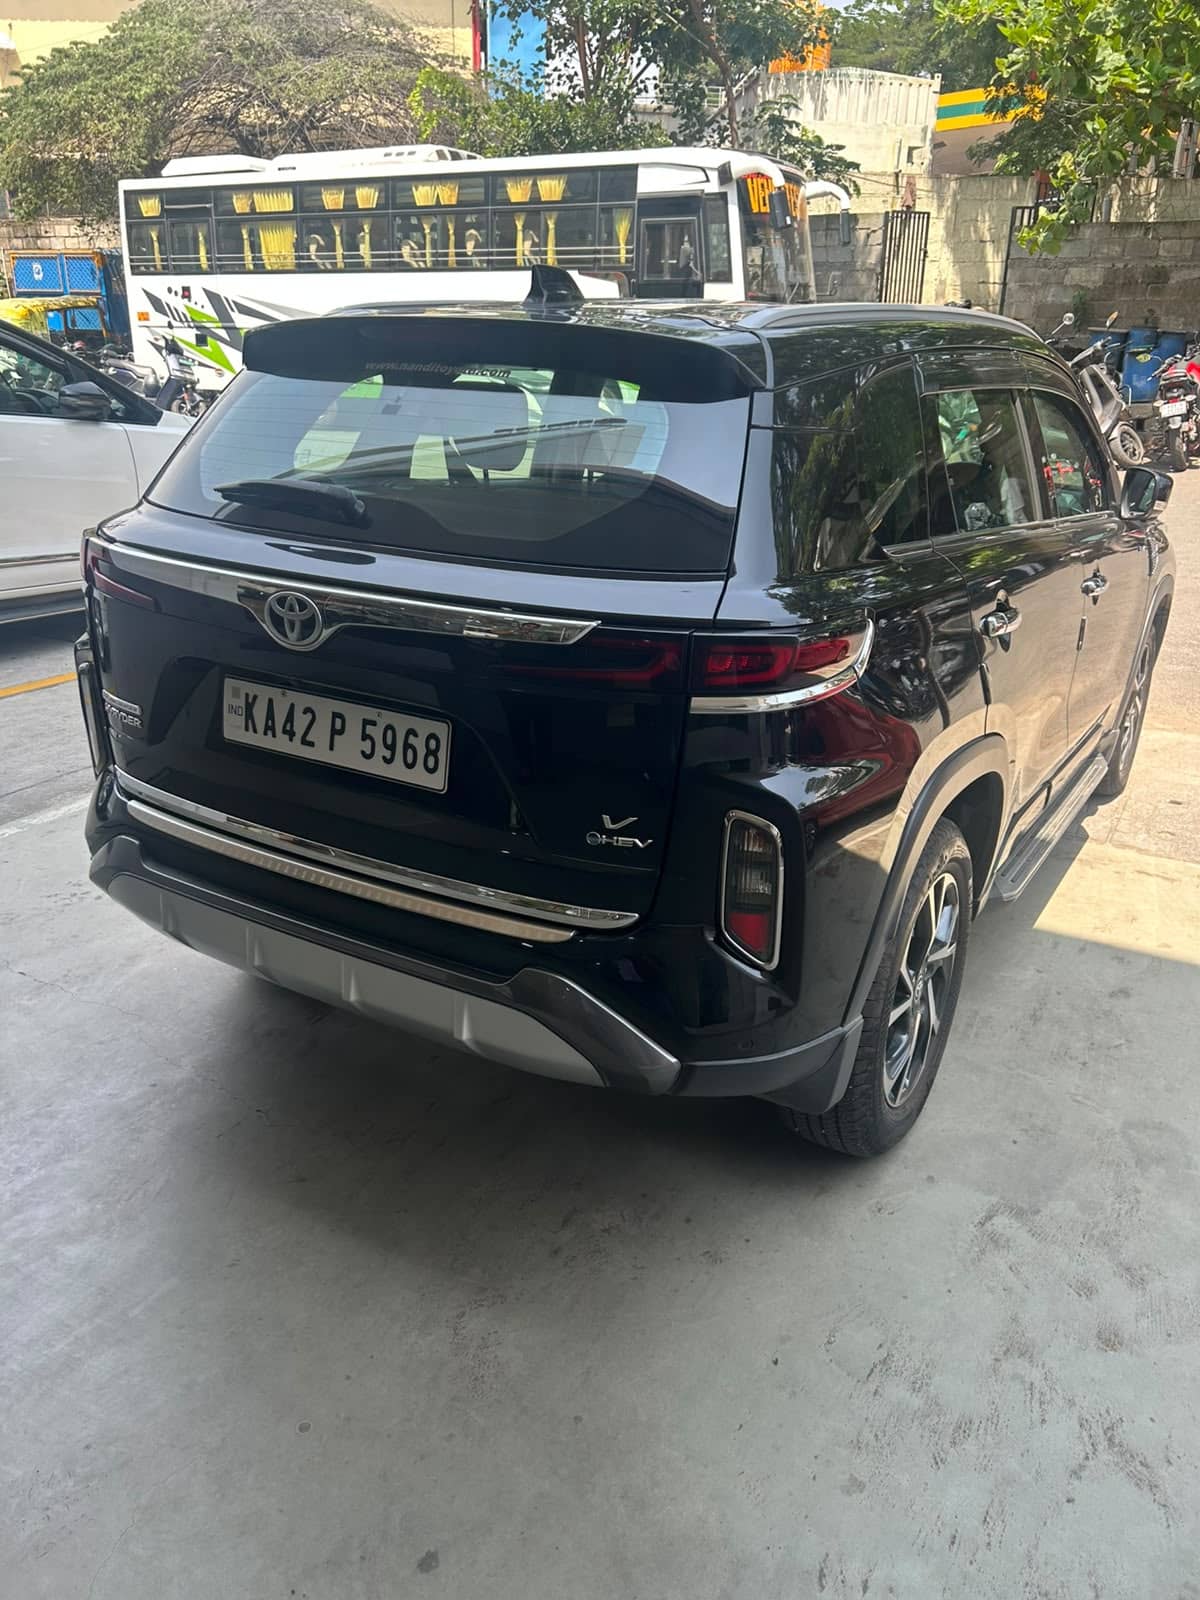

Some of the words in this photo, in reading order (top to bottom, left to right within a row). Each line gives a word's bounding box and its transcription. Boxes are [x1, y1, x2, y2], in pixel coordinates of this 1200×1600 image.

[228, 703, 243, 717] IND
[244, 692, 316, 748] KA42
[329, 711, 346, 751] P
[360, 718, 441, 774] 5968
